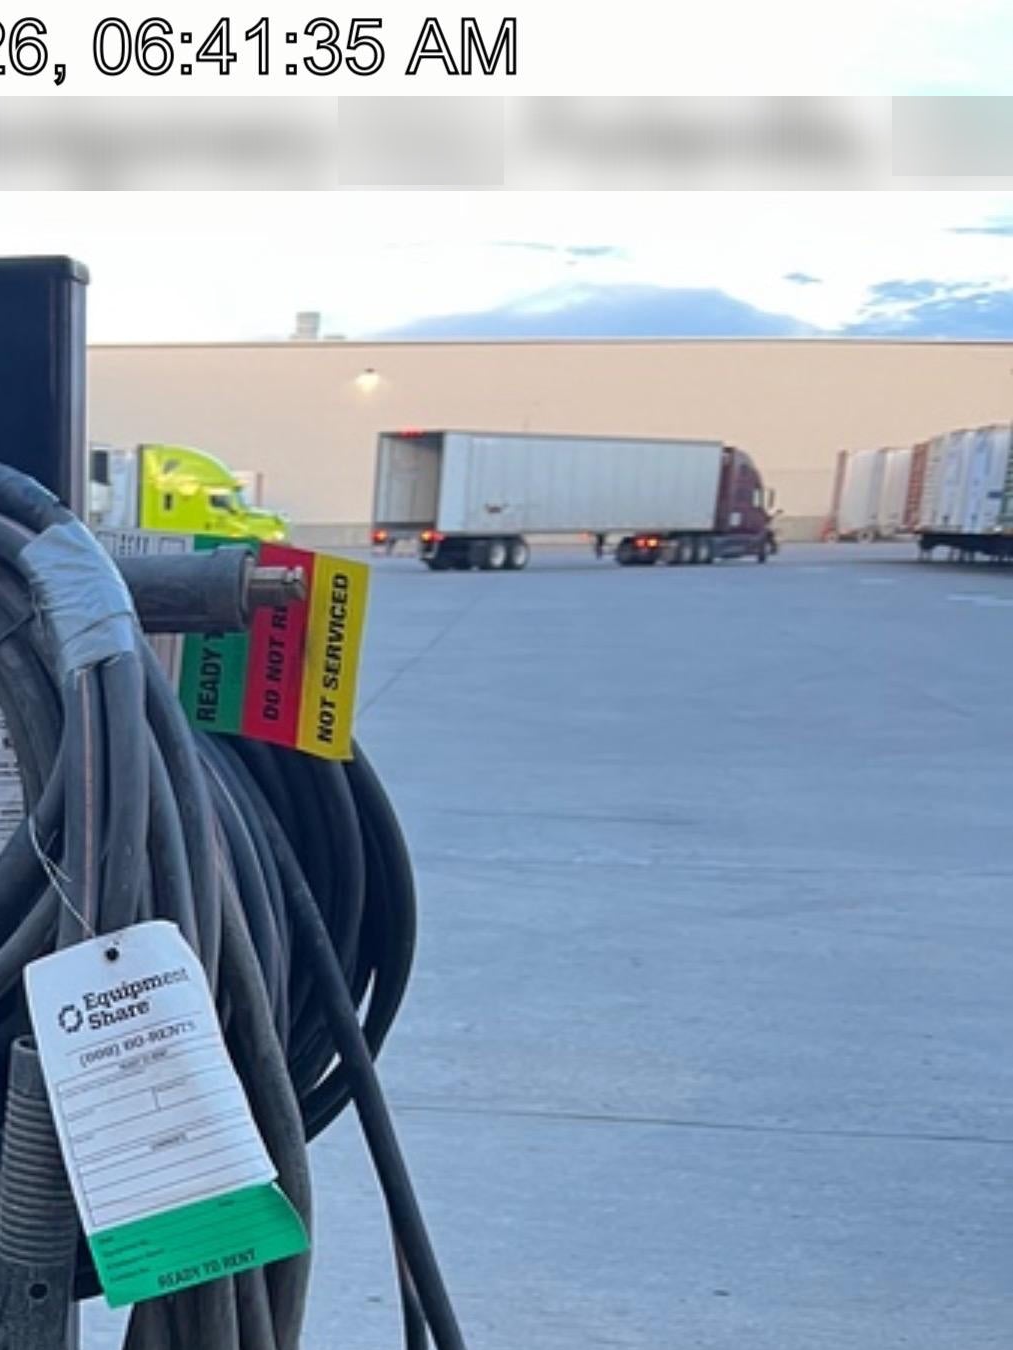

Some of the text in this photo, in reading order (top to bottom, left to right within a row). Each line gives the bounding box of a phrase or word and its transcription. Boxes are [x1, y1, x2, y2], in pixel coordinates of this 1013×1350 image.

[266, 637, 285, 683] NOT
[317, 572, 349, 744] NOT SERVICED
[196, 647, 224, 721] READY
[263, 690, 281, 720] DO
[82, 967, 190, 1011] Equipment
[88, 1000, 151, 1030] Share
